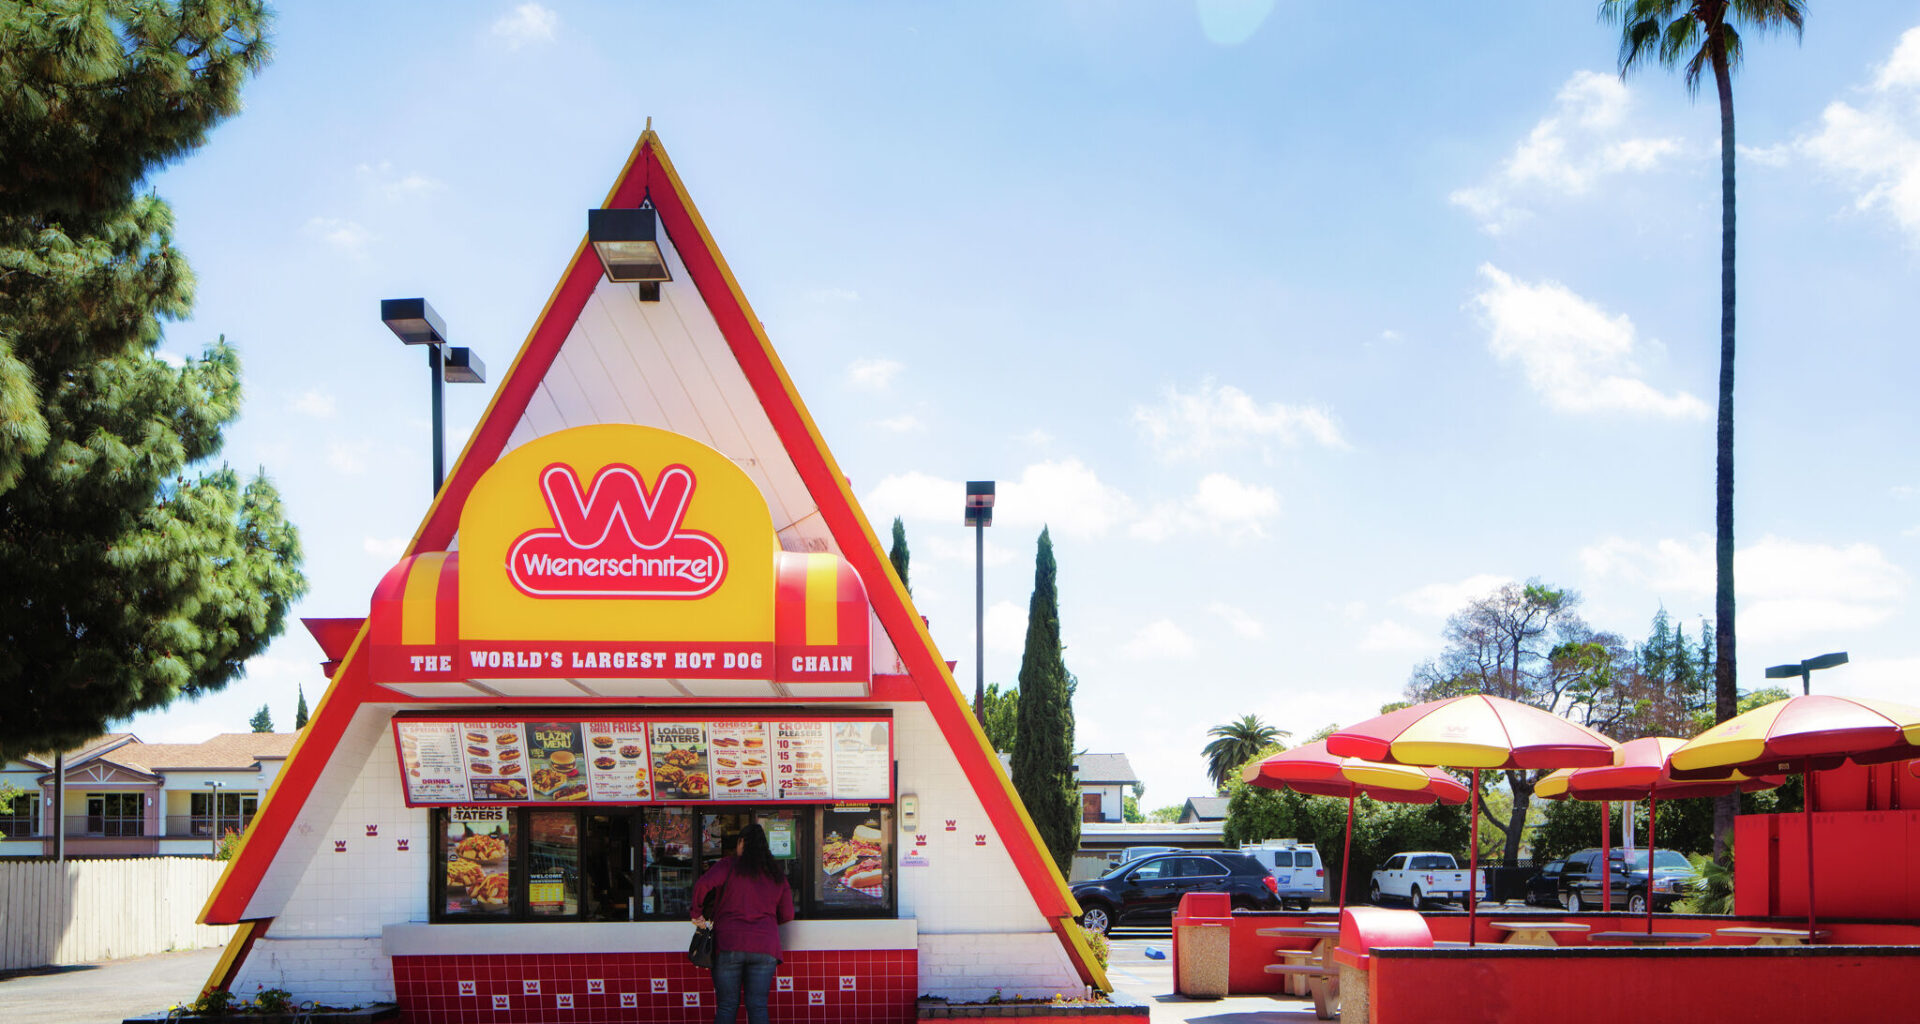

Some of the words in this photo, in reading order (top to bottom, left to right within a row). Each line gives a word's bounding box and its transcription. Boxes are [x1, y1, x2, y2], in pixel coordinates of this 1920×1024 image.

[543, 467, 692, 549] W
[522, 553, 713, 583] Wienerschnitzel
[410, 655, 452, 672] THE
[471, 651, 564, 669] WORLD'S
[572, 651, 667, 669] LARGEST
[675, 651, 716, 669] HOT
[723, 651, 763, 670] DOG
[791, 655, 853, 672] CHAIN
[613, 722, 641, 733] FRIES
[778, 722, 822, 730] CROWD
[535, 730, 572, 741] BLAZIN'
[658, 735, 700, 743] TATERS
[543, 740, 572, 749] MENU
[776, 740, 789, 749] $10
[777, 752, 789, 760] $15
[778, 764, 792, 773] $20
[779, 779, 793, 788] $25
[456, 811, 503, 820] TATERS
